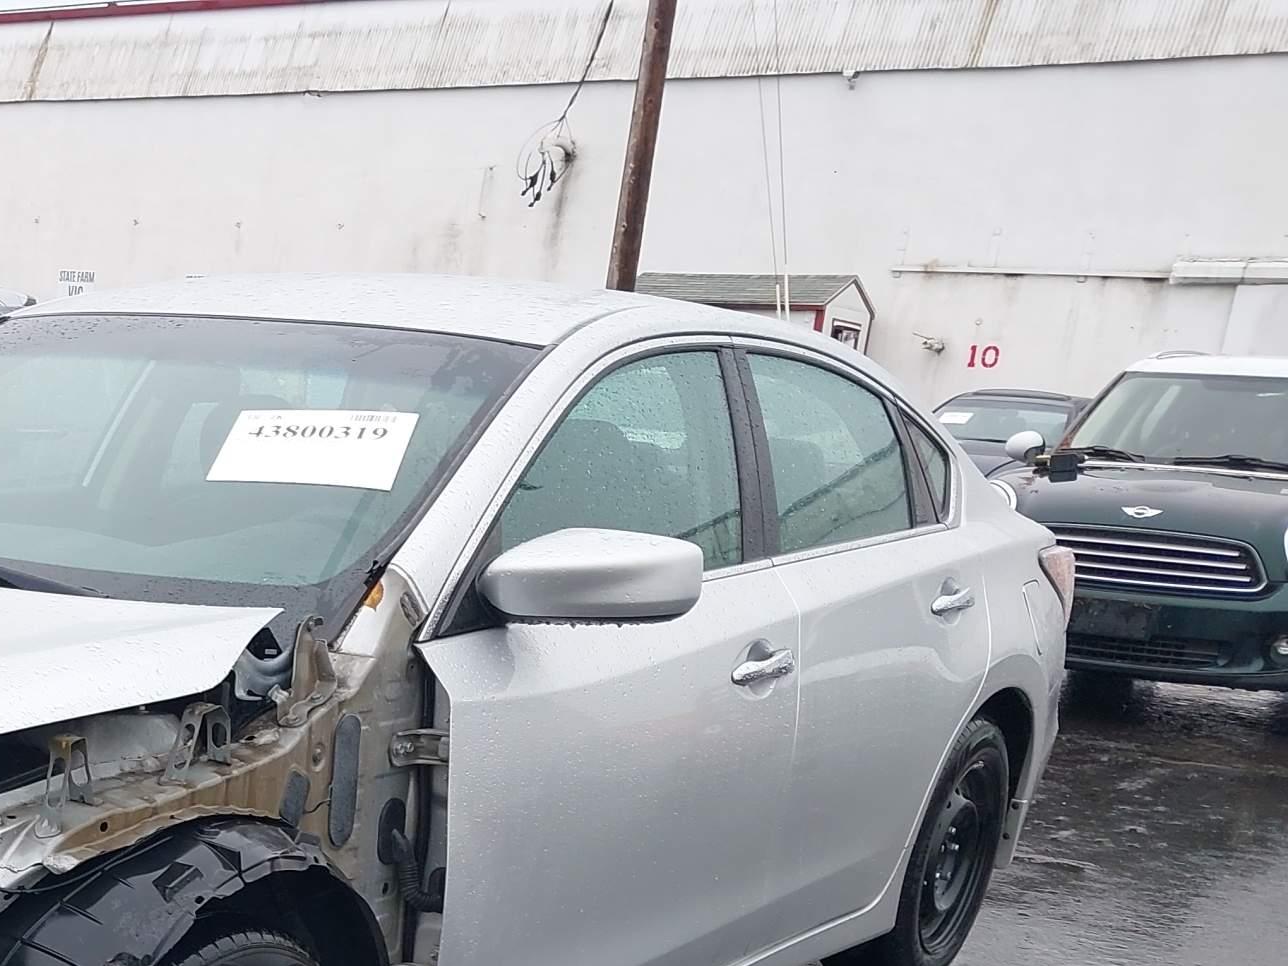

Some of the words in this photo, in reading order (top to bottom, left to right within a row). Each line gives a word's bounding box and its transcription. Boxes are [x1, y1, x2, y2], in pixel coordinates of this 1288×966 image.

[59, 271, 76, 283] STATE
[77, 271, 95, 283] FARM
[967, 345, 1000, 368] 10
[247, 424, 389, 440] 43800319
